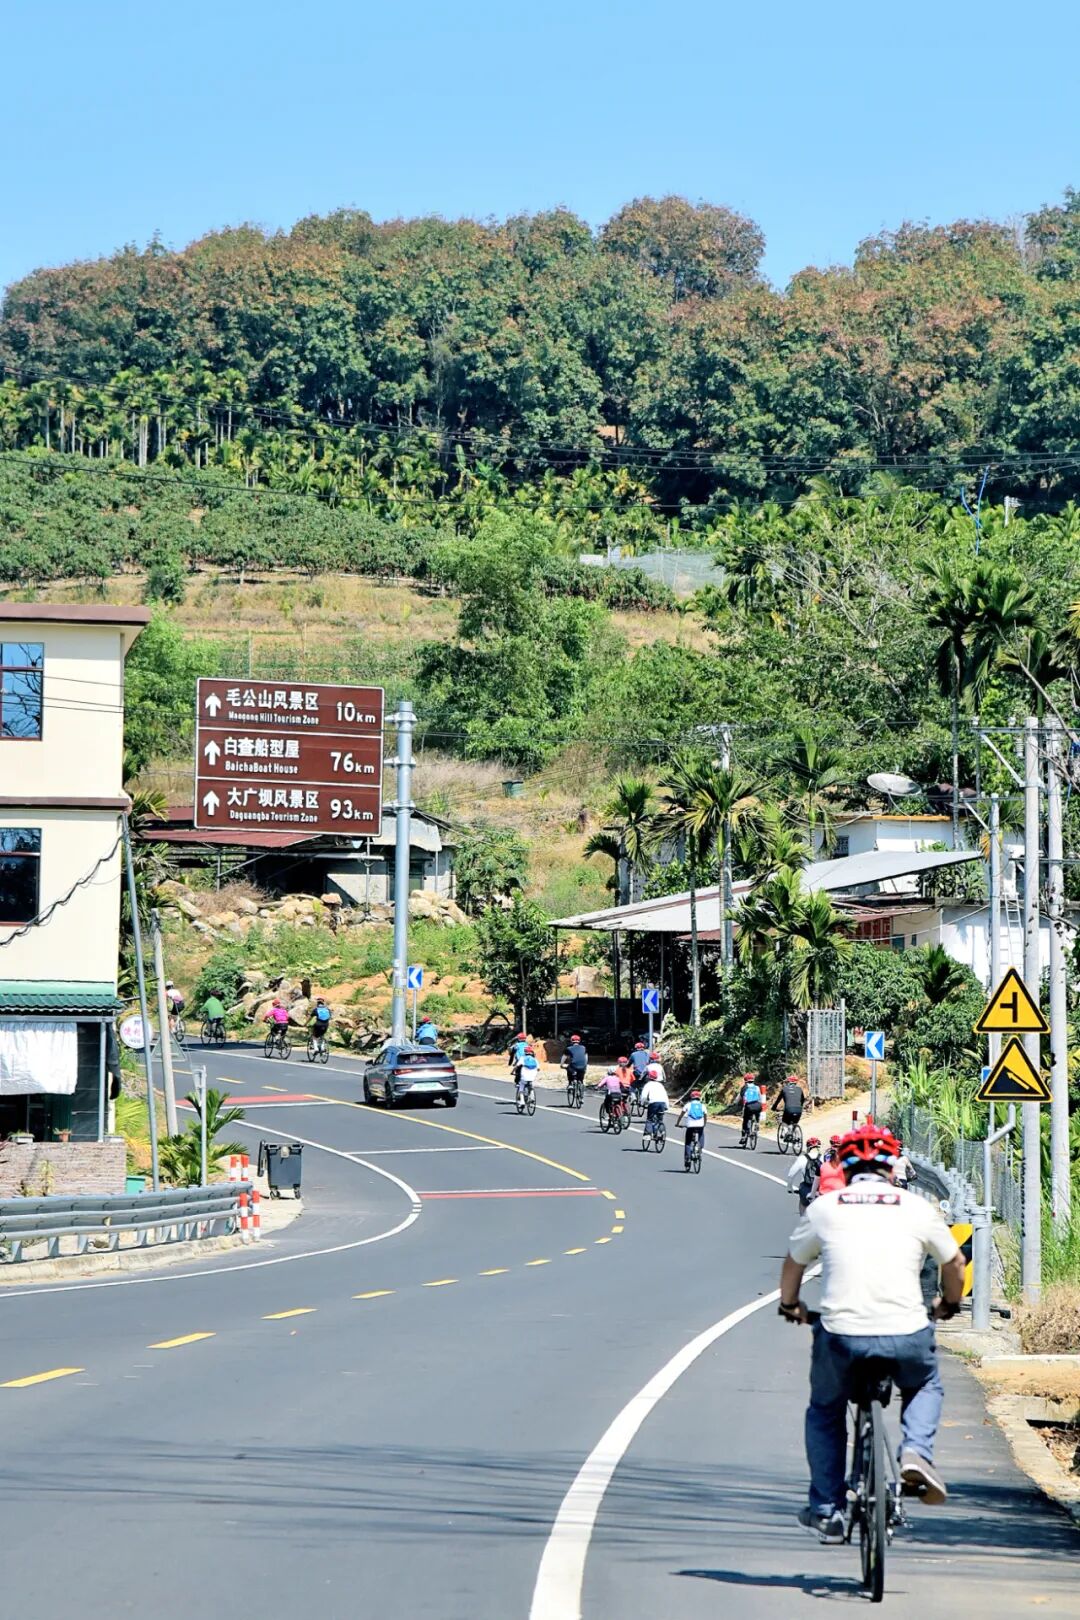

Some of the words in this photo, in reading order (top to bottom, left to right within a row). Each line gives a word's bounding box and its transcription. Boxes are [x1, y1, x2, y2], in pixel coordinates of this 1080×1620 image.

[226, 688, 319, 711] 毛公山风景区
[259, 712, 273, 723] Hill
[273, 713, 302, 724] Tourism
[302, 714, 319, 725] Zone
[224, 736, 300, 759] 白查船型屋
[273, 762, 298, 774] House
[227, 786, 319, 809] 大广坝风景区
[229, 809, 270, 822] Daguangba
[270, 811, 300, 822] Tourism
[300, 812, 318, 823] Zone
